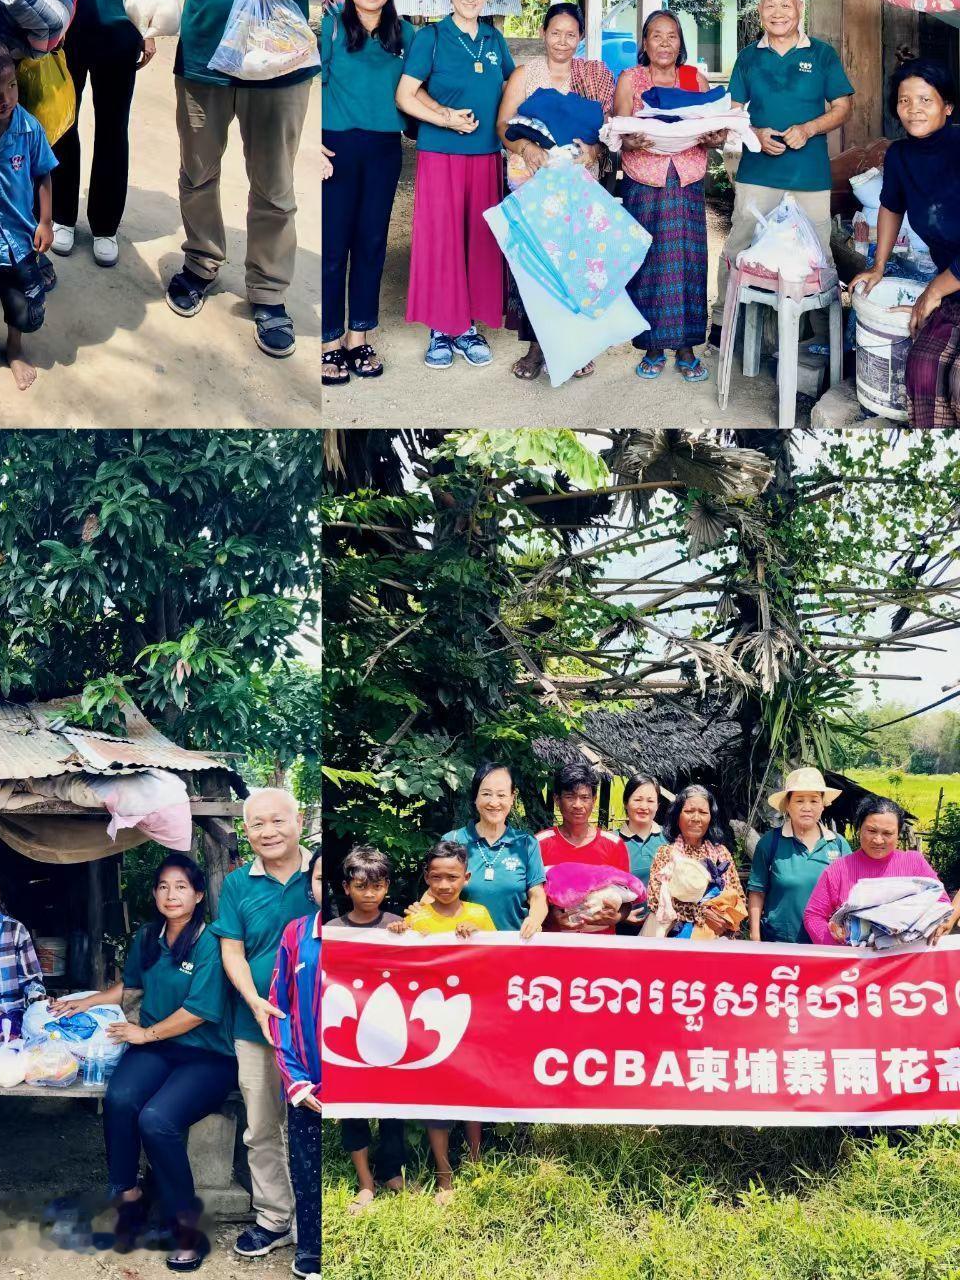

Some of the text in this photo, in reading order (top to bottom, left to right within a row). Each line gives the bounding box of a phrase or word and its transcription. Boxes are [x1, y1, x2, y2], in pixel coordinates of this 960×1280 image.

[507, 965, 960, 1036] អាហារបួសអ៊ីហ័រចា
